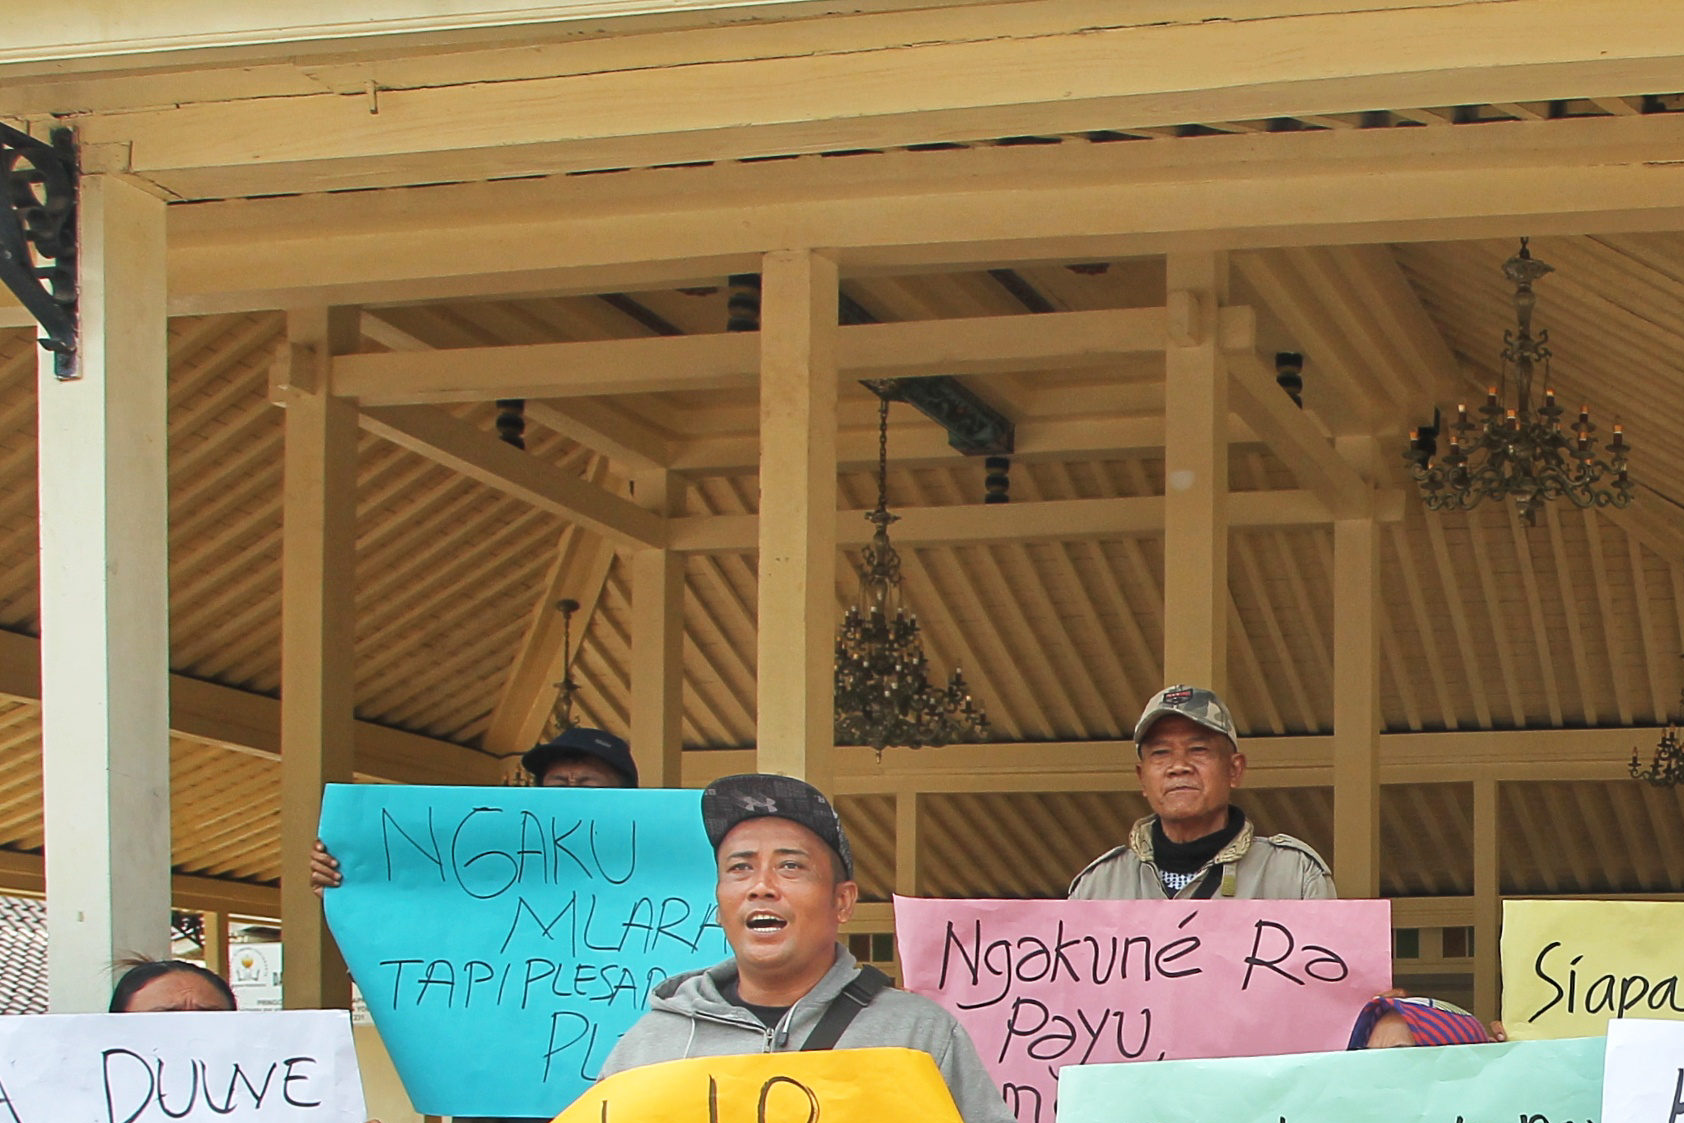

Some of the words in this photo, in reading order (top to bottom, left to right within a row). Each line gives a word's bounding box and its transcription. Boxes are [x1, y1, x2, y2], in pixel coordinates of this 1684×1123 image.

[381, 806, 636, 899] NGAKU
[500, 891, 727, 957] MLARA
[939, 911, 1201, 1009] Ngakuné
[1243, 920, 1349, 990] Ra
[380, 959, 511, 1010] TAPI
